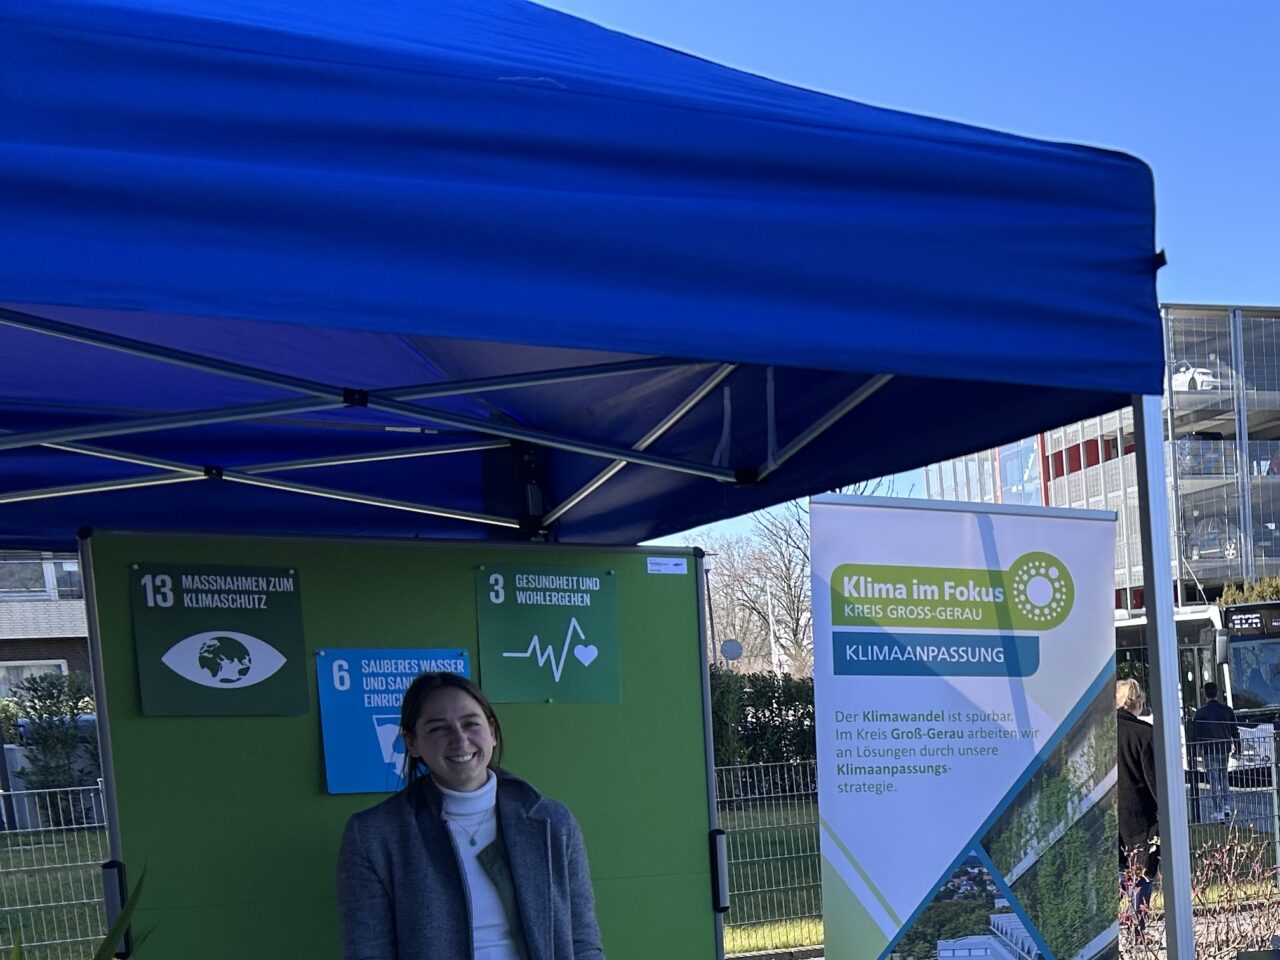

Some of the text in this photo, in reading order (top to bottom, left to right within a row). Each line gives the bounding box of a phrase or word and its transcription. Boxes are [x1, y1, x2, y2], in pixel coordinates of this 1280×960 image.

[141, 574, 174, 607] 13
[182, 575, 294, 592] MASSNAHMEN ZUM
[489, 573, 505, 604] 3
[515, 574, 600, 591] GESUNDHEIT UND
[843, 576, 1005, 603] Klima im Fokus
[184, 593, 267, 608] KLIMASCHUTZ
[516, 591, 590, 606] WOHLERGEHEN
[844, 604, 982, 621] KREIS GROSS-GERAU
[846, 645, 1004, 663] KLIMAANPASSUNG
[361, 659, 464, 673] SAUBERES WASSER
[332, 659, 350, 691] 6
[363, 676, 386, 690] UND
[835, 710, 1013, 725] Der Klimawandel ist spürbar.
[835, 728, 1040, 741] Im Kreis Groß-Gerau arbeiten wir
[836, 744, 999, 760] an Lösungen durch unsere
[836, 763, 951, 777] Klimaanpassungs-
[837, 781, 898, 795] strategie.
